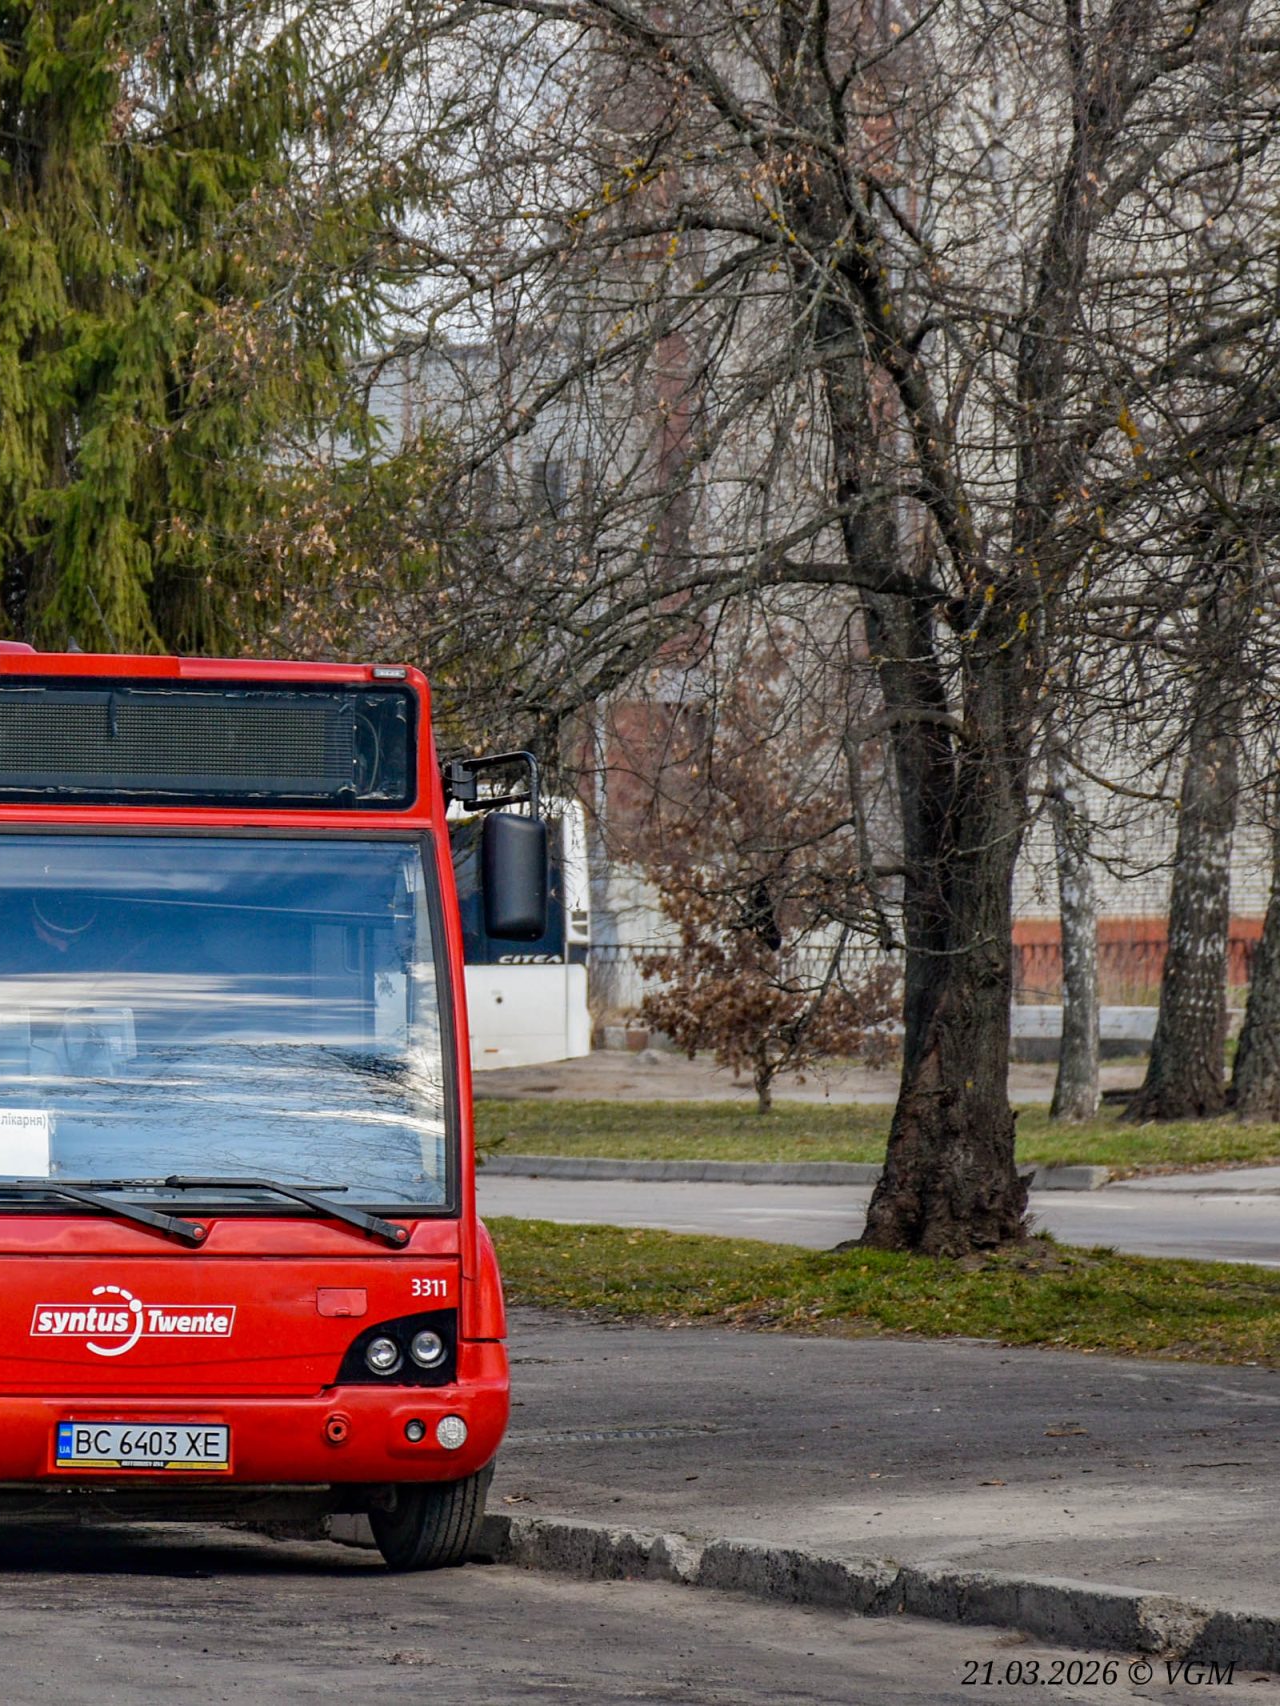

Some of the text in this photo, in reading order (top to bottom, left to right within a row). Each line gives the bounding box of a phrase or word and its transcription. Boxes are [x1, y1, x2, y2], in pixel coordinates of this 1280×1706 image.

[499, 954, 562, 964] CITEA
[1, 1113, 46, 1129] лікарня)
[411, 1278, 447, 1297] 3311
[37, 1307, 228, 1334] syntus Twente
[59, 1445, 71, 1454] UA
[75, 1430, 220, 1457] BC 6403 XE
